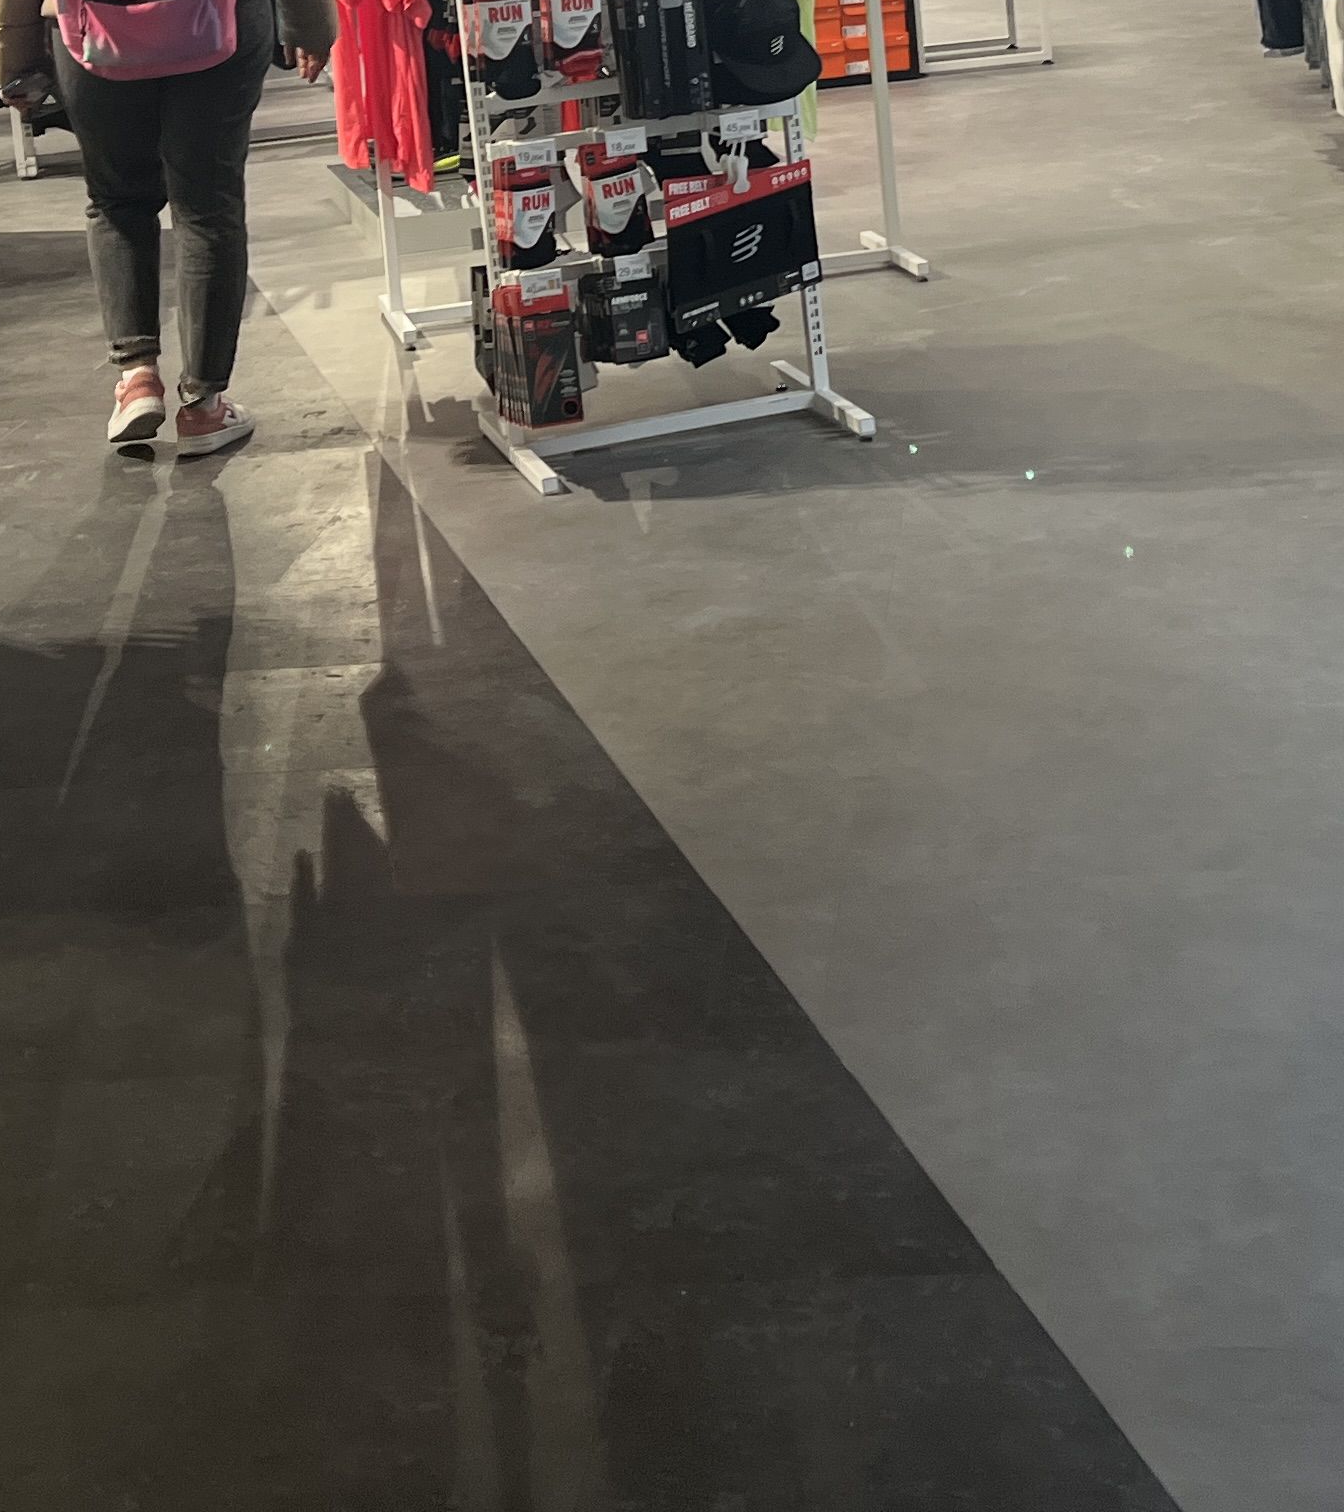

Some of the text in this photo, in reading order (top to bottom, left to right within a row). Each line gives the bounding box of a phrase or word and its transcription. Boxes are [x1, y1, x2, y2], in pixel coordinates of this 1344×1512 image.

[488, 3, 523, 25] RUN
[601, 176, 635, 200] RUN
[521, 191, 550, 212] RUN
